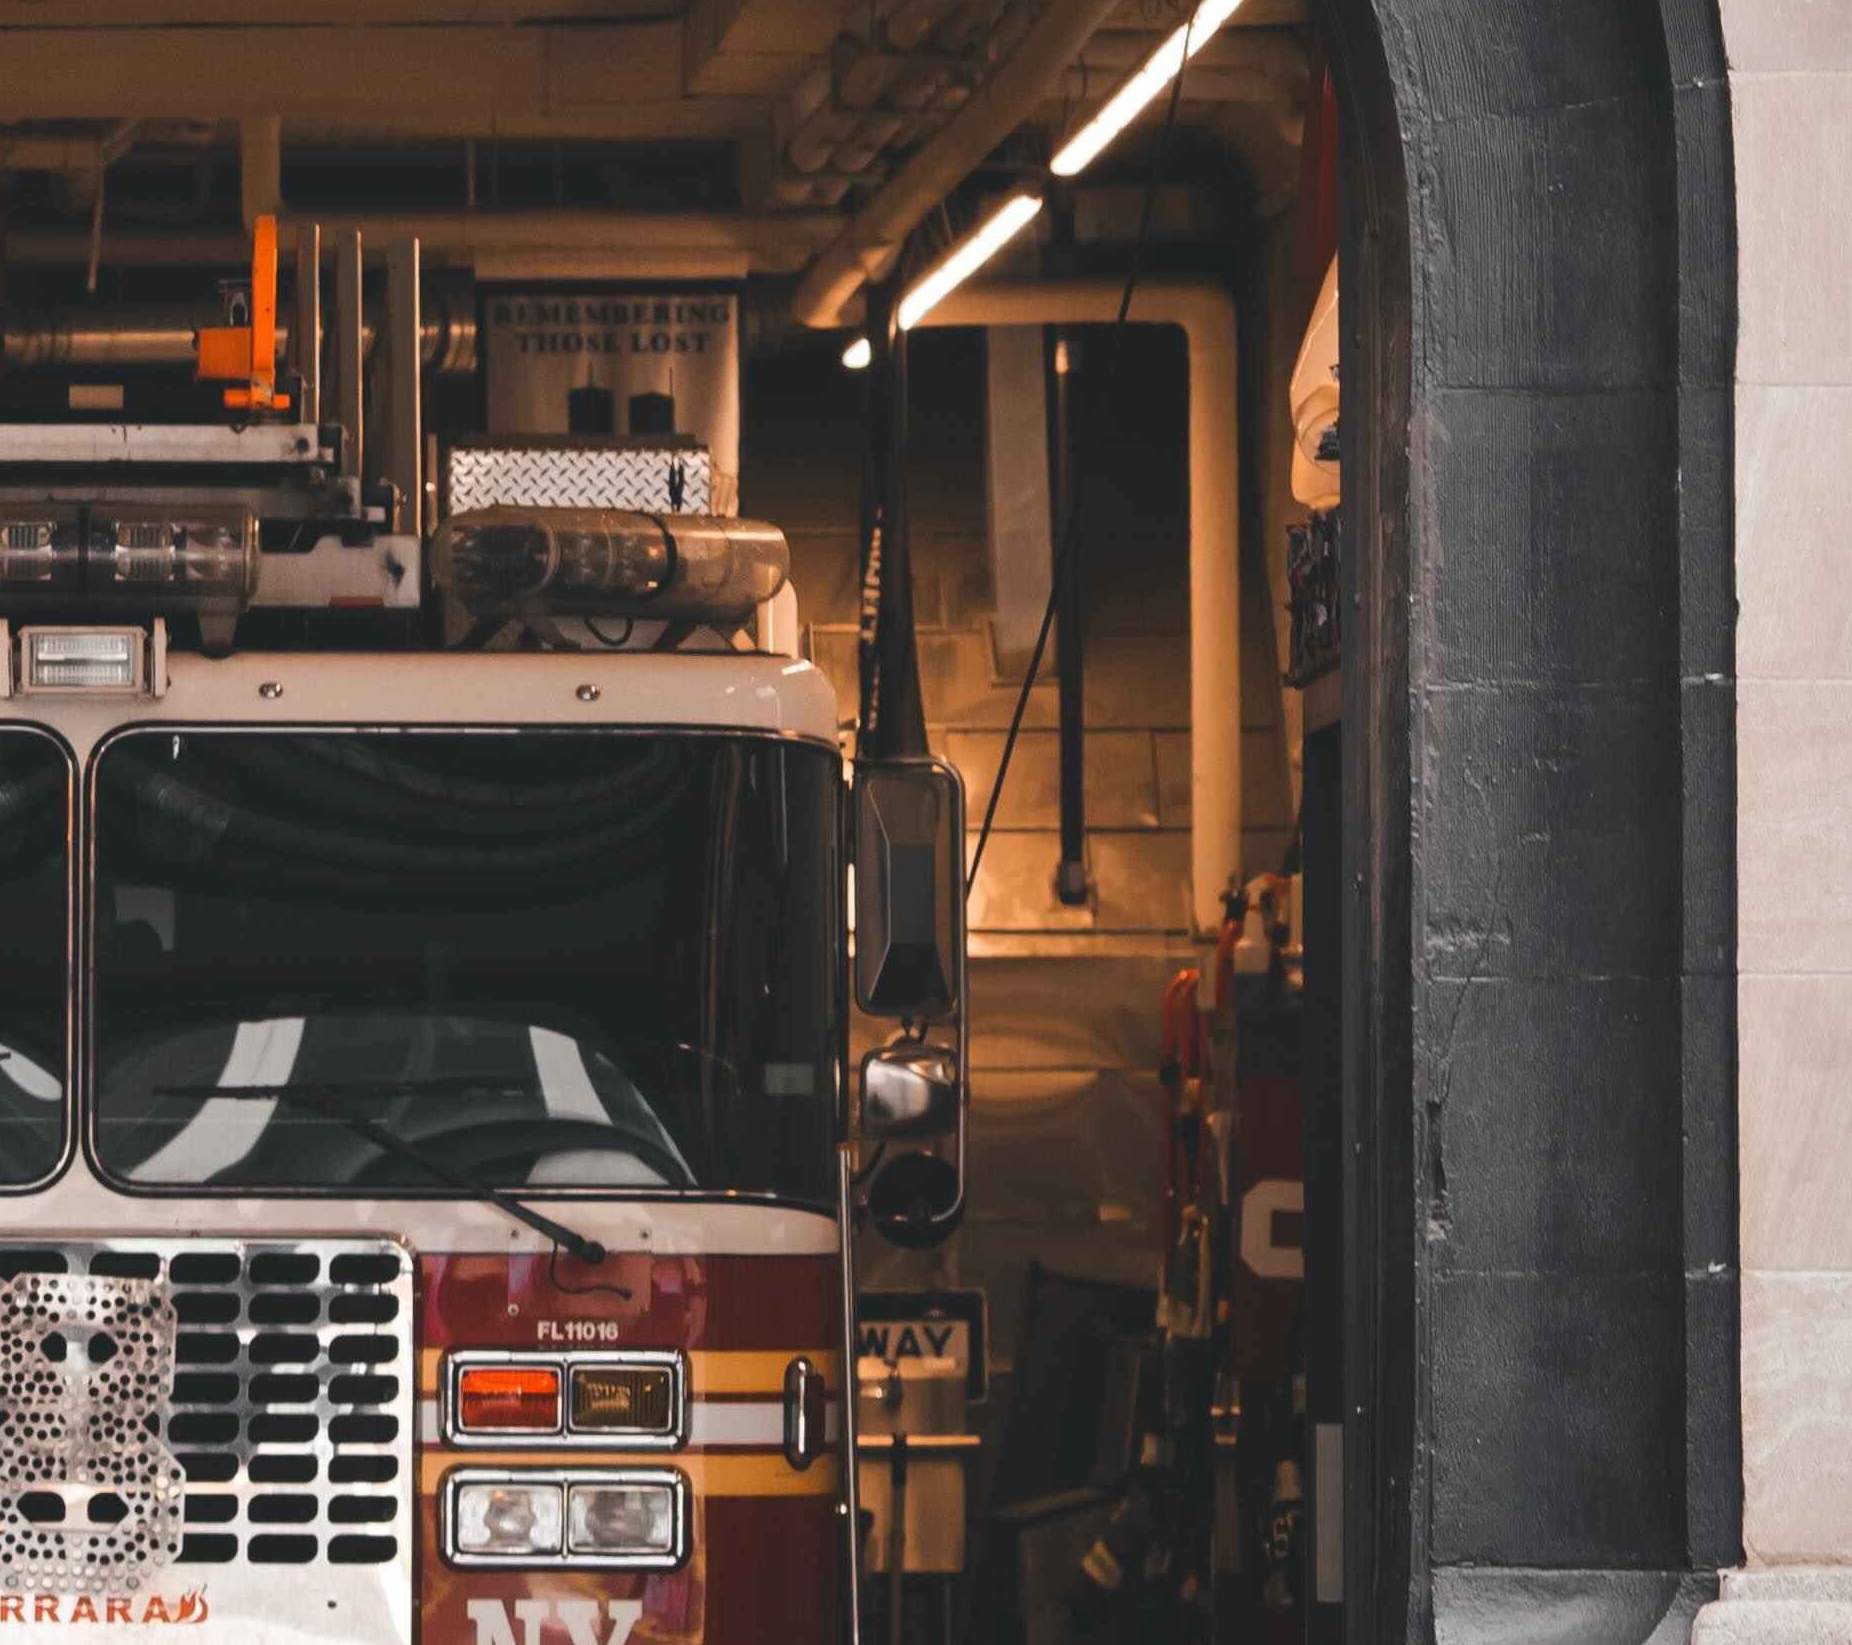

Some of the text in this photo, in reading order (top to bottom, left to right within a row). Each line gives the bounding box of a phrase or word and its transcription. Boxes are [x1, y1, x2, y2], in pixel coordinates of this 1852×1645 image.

[494, 303, 730, 325] REMEMBERING
[516, 332, 710, 354] THOSE LOST
[537, 1322, 619, 1341] FL11016
